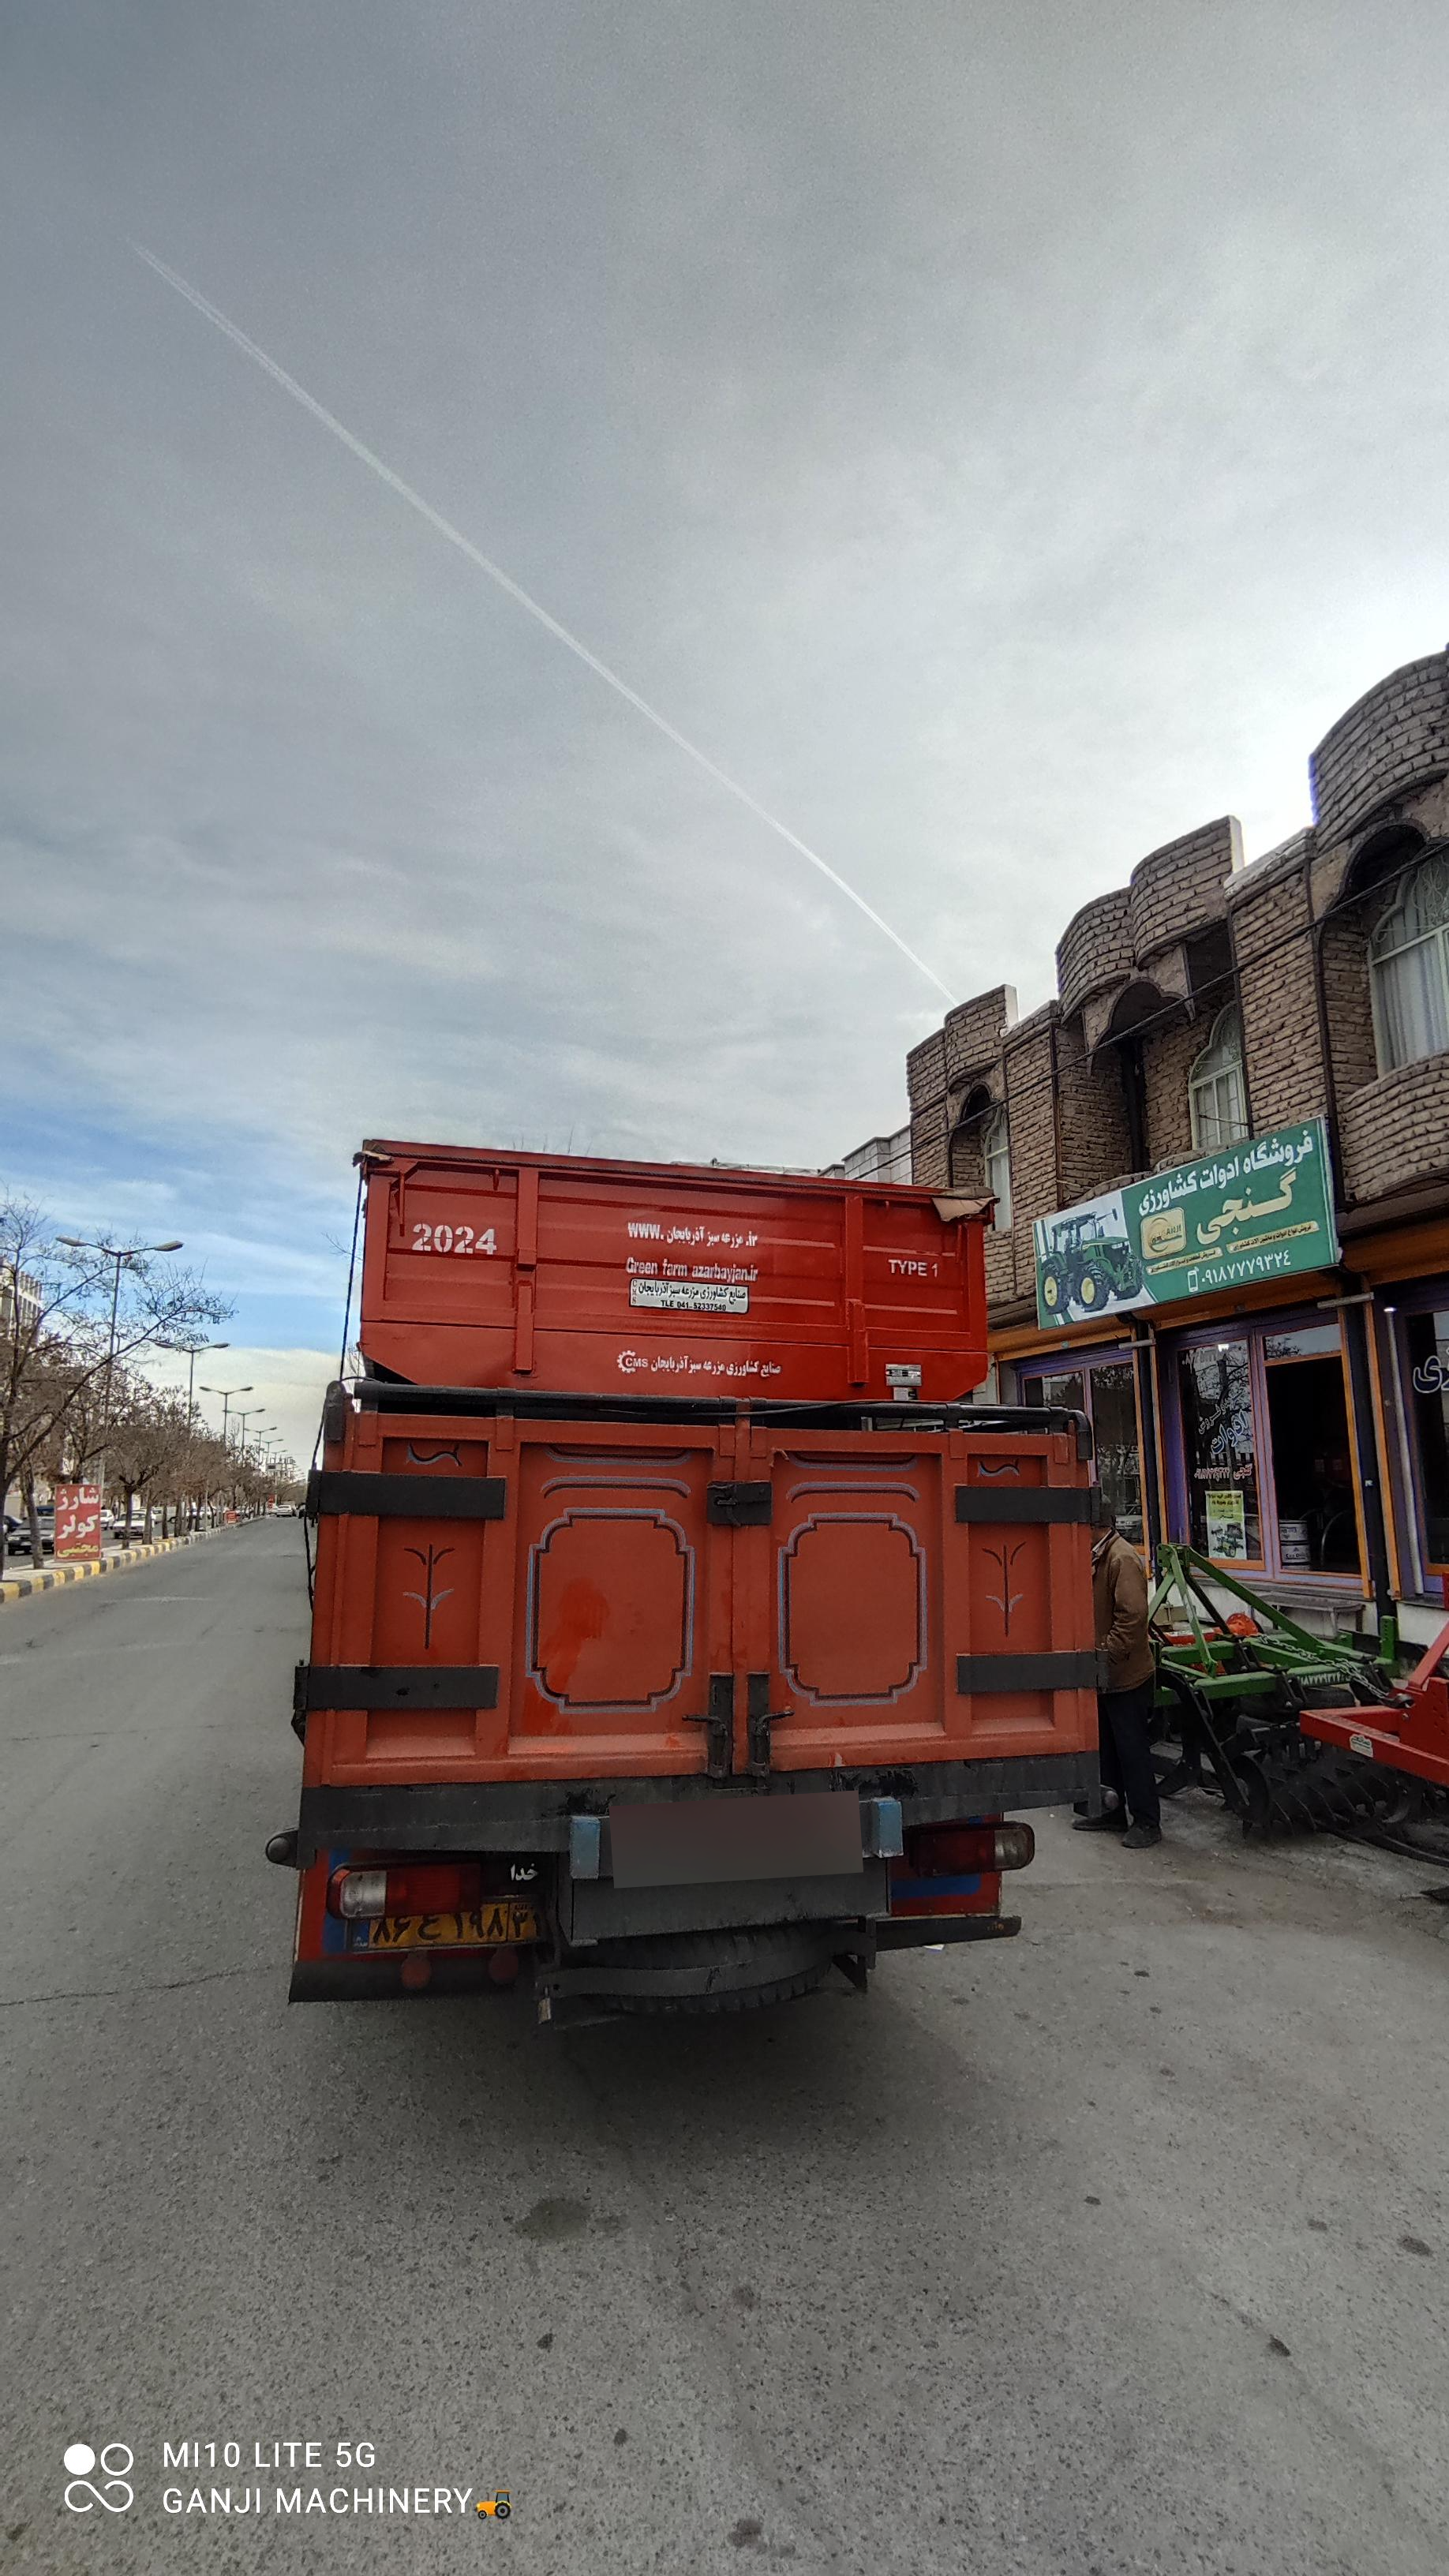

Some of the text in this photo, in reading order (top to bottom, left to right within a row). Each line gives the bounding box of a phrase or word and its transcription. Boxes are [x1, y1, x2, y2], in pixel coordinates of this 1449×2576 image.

[1139, 1129, 1313, 1216] فروشگاه ادوات کشاورزی
[1196, 1166, 1297, 1245] گنجی
[411, 1222, 497, 1255] 2024
[706, 1230, 720, 1247] سبز
[626, 1256, 758, 1284] Green farm azarbayjan.ir
[888, 1259, 938, 1278] TYPE 1
[661, 1299, 674, 1308] TLE
[699, 1286, 728, 1301] کشاورزی
[728, 1288, 747, 1305] صنایع
[1210, 1408, 1249, 1455] ادوات
[57, 1487, 99, 1511] شارژ
[57, 1515, 99, 1539] کولر
[57, 1542, 99, 1558] مجتبی
[510, 1863, 538, 1881] خدا
